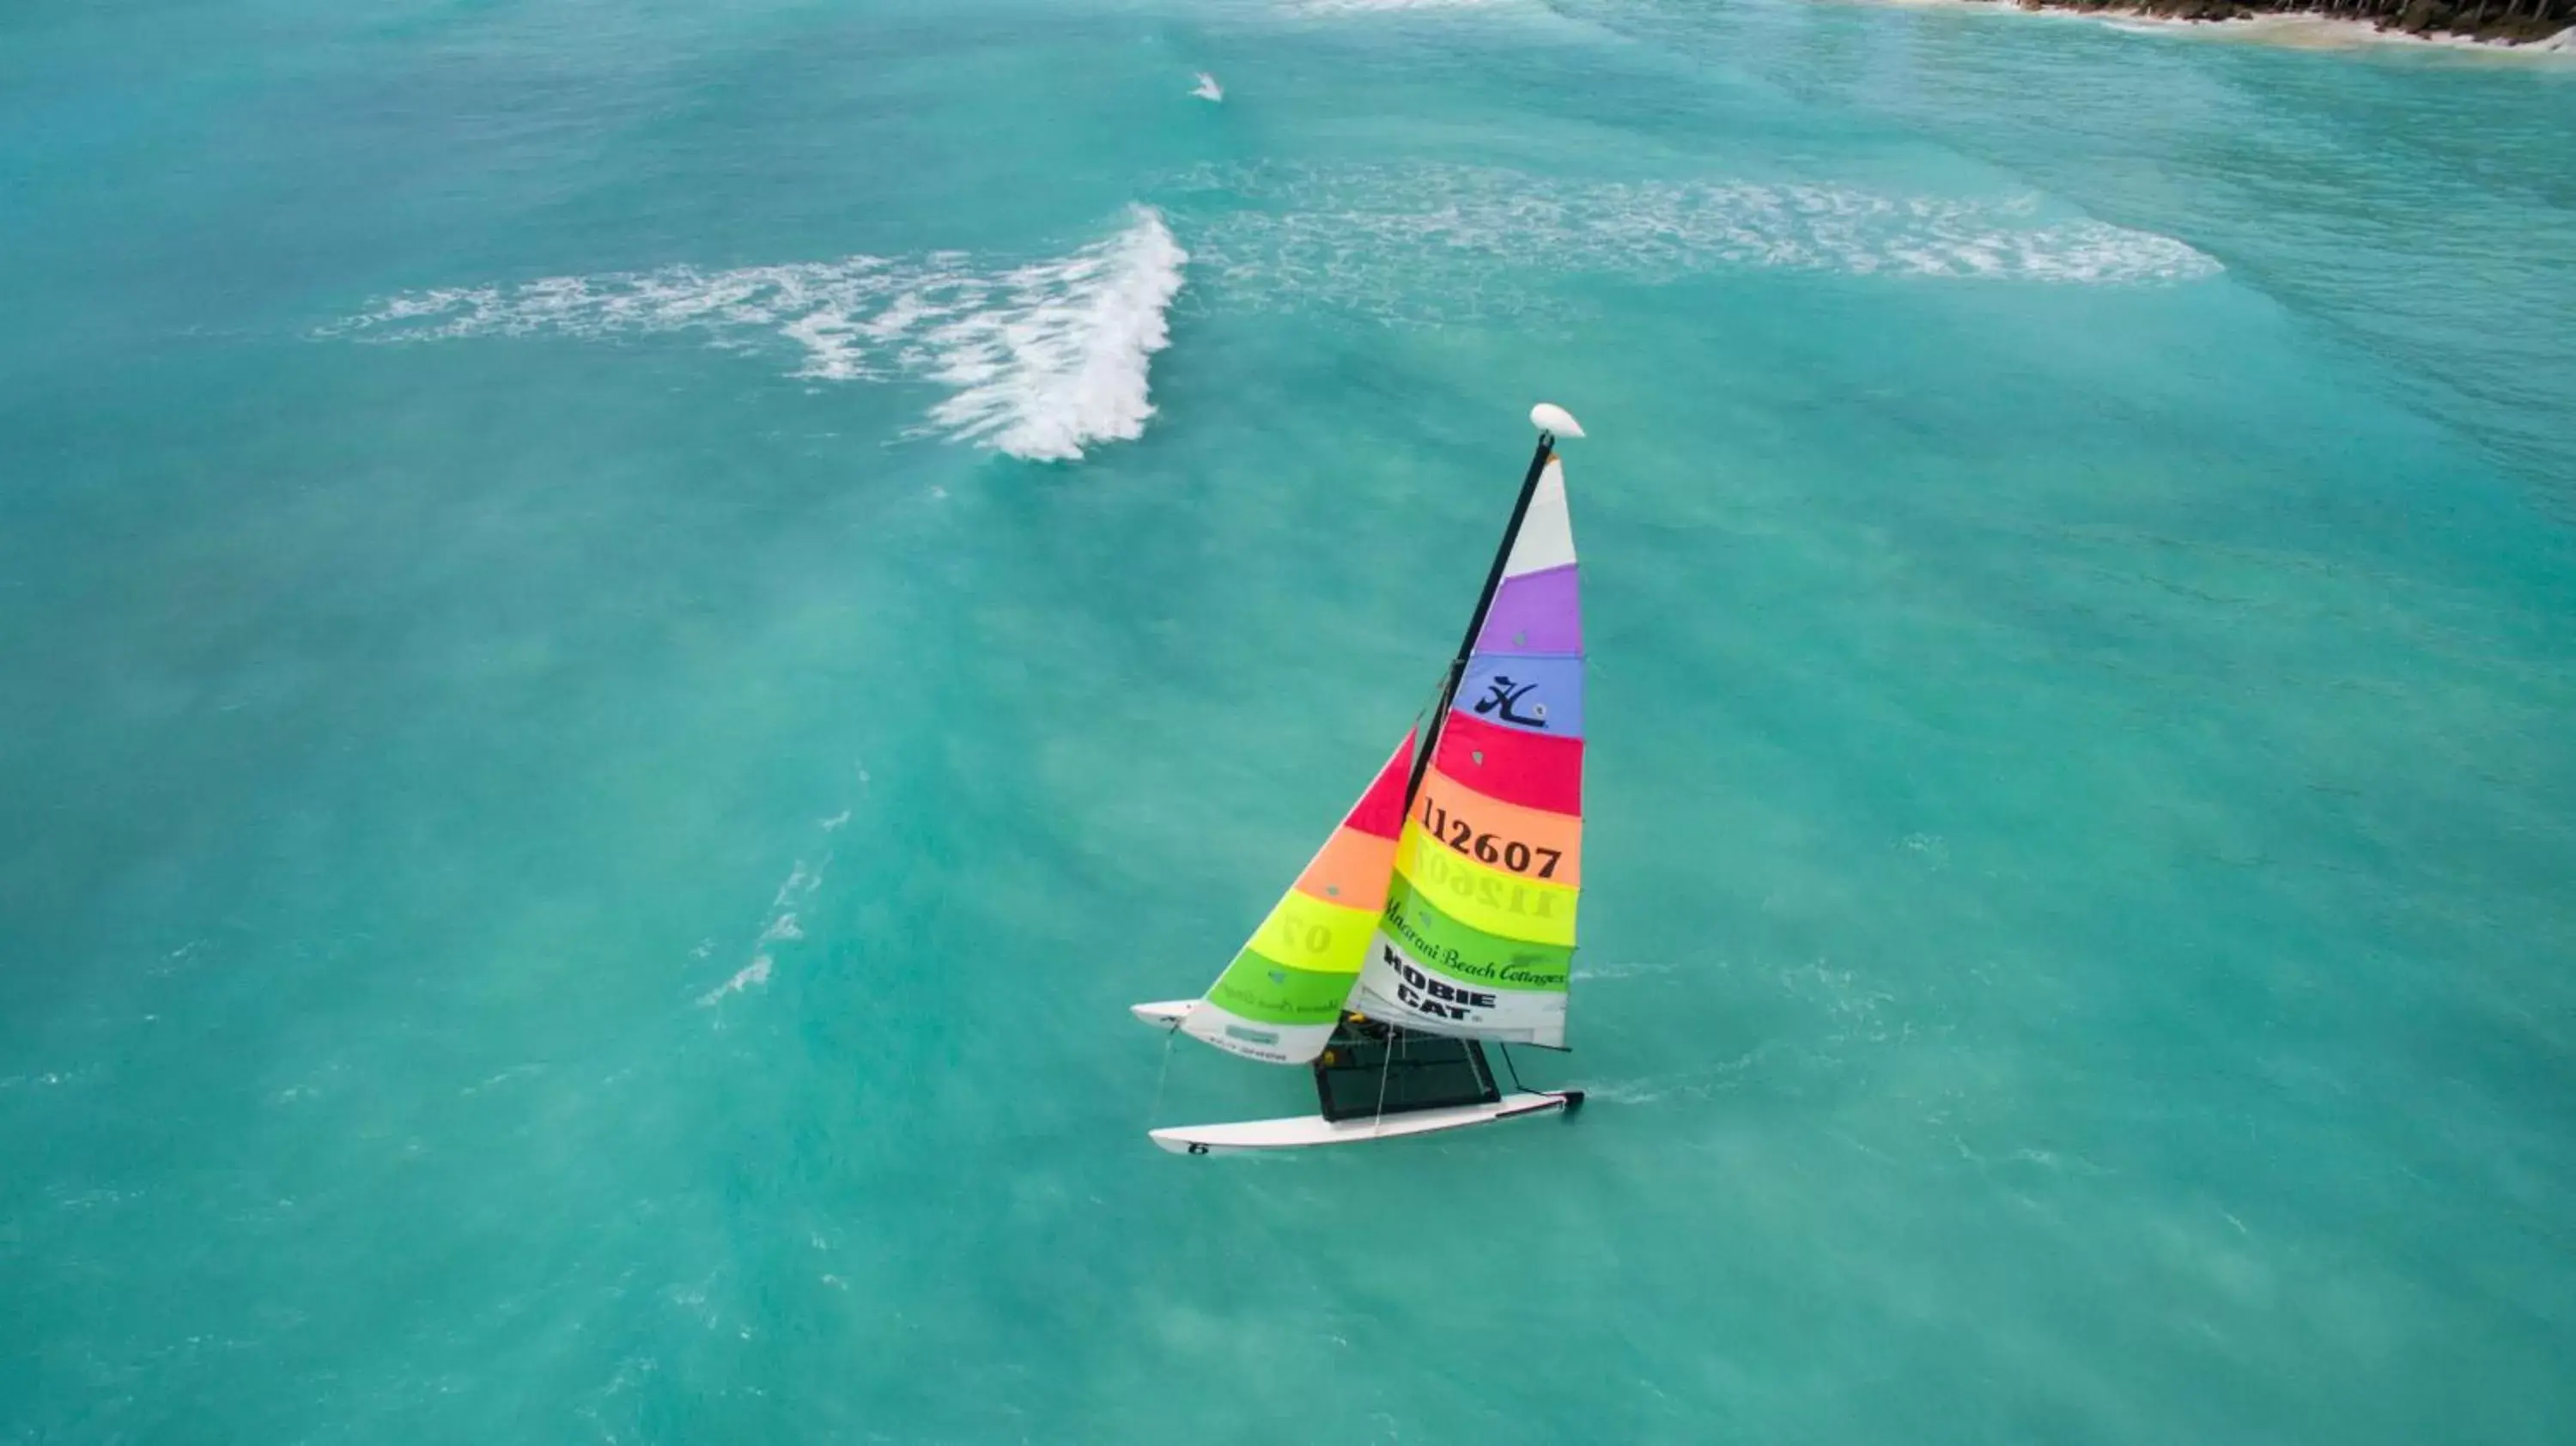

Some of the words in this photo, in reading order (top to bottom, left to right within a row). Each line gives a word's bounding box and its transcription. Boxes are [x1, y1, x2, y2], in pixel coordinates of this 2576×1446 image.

[1422, 796, 1563, 878] 112607
[1384, 945, 1497, 1009] HOBIE
[1440, 948, 1495, 979] Beach
[1500, 963, 1566, 987] Cottages
[1397, 984, 1471, 1020] CAT
